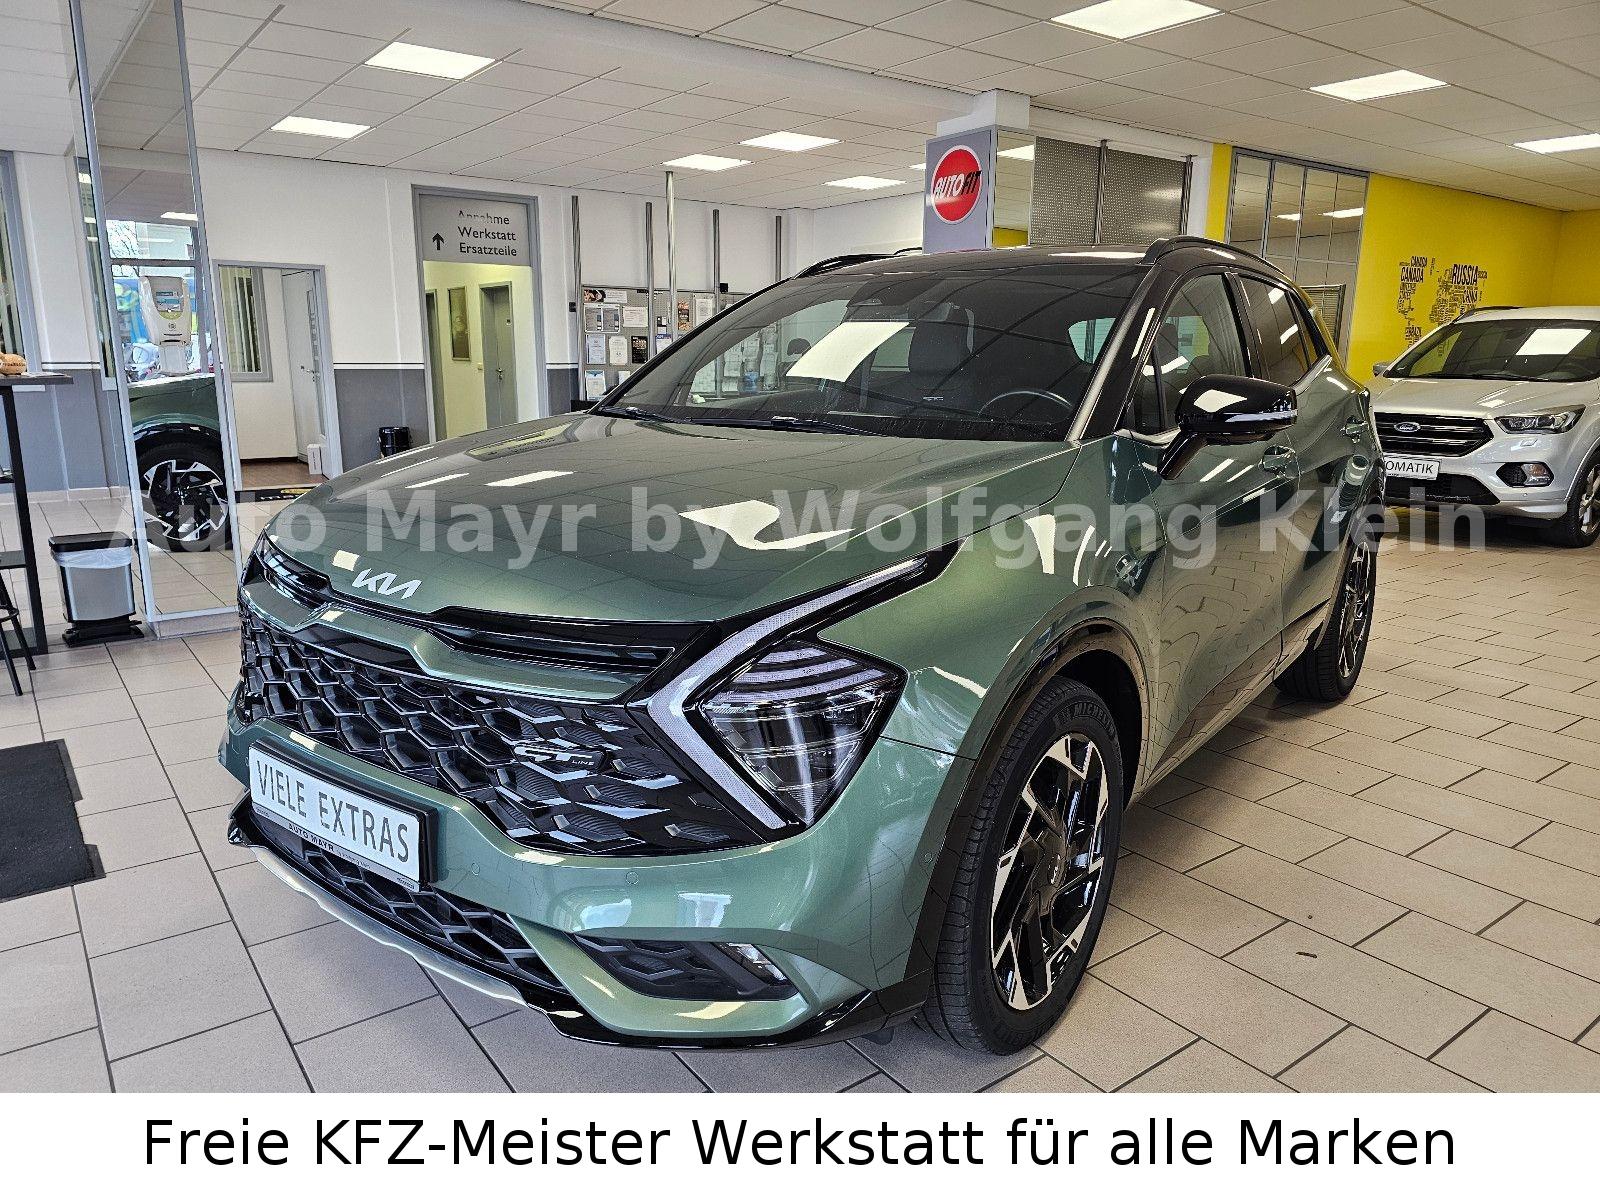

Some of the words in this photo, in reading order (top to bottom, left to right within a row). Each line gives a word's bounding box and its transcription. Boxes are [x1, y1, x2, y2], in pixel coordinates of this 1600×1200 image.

[934, 170, 982, 198] AUTOFIT
[457, 226, 517, 241] Werkstatt
[459, 242, 517, 256] Ersatzteile
[1400, 266, 1424, 283] CANADA
[1452, 264, 1478, 285] RUSSIA
[256, 760, 307, 818] VIELE
[318, 791, 409, 863] EXTRAS
[288, 822, 309, 839] AUTO
[311, 837, 334, 852] MAYR
